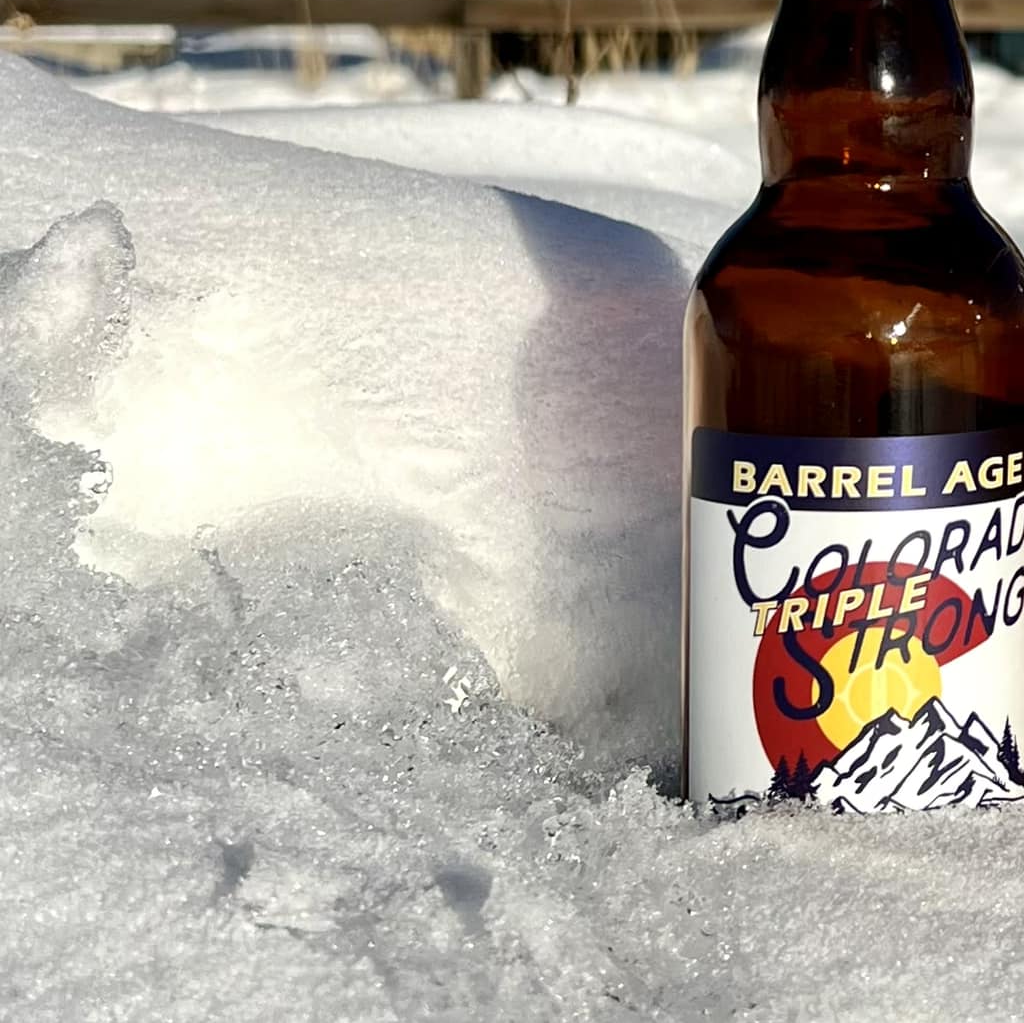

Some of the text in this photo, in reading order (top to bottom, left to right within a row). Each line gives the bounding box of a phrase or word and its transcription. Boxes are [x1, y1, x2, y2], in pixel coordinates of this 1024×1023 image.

[733, 460, 926, 499] BARREL
[752, 573, 932, 637] TRIPLE
[773, 566, 1024, 720] STRONG
